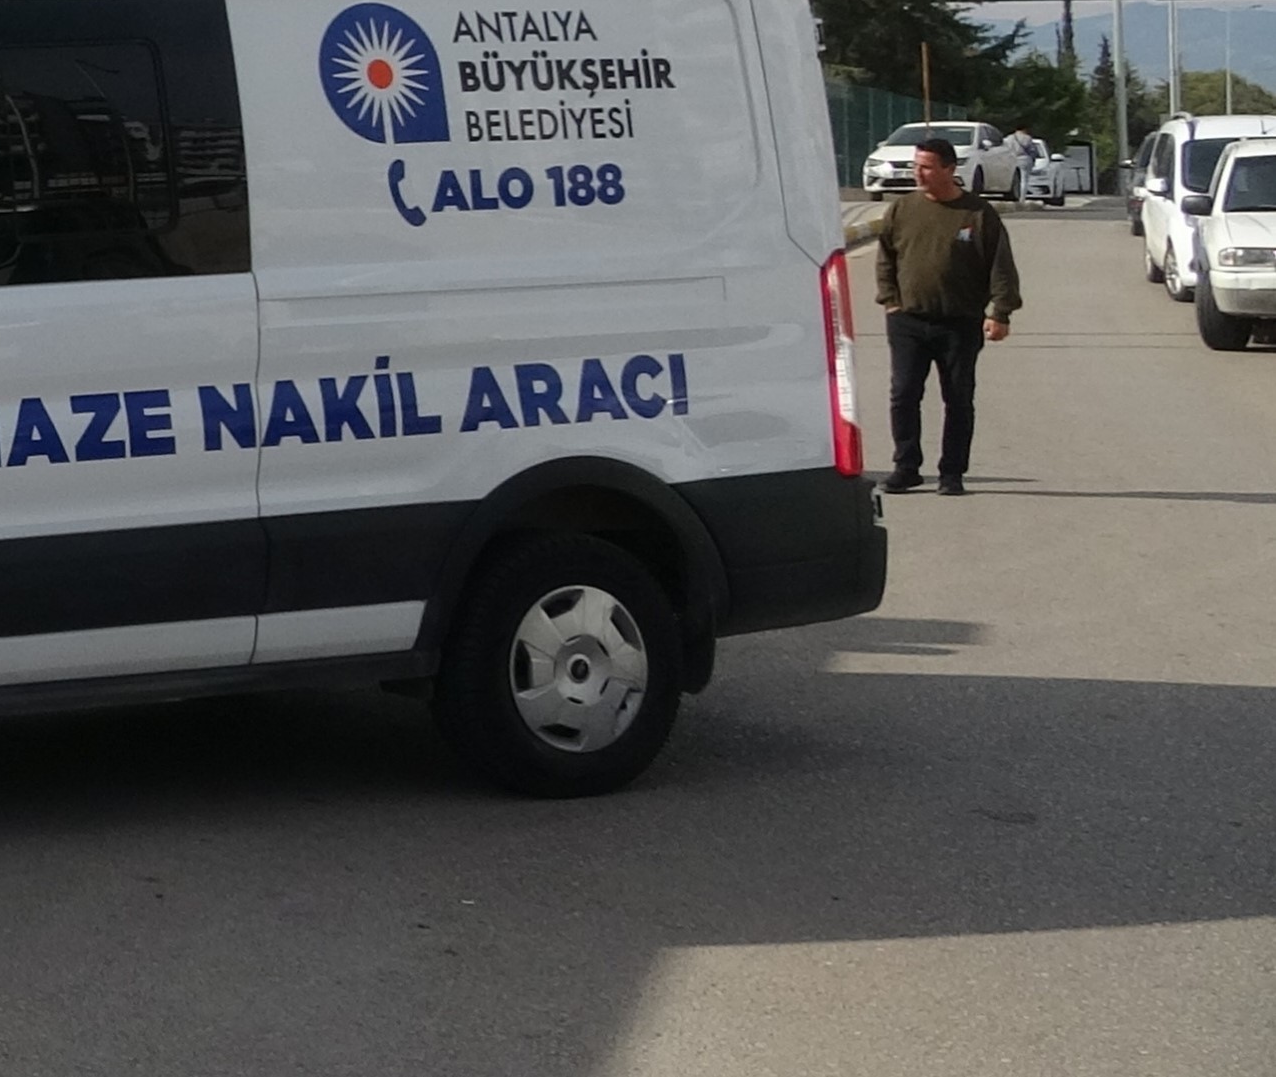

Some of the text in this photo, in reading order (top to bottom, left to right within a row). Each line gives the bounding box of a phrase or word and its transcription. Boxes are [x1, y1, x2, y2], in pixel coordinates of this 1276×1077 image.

[452, 10, 598, 44] ANTALYA
[459, 50, 677, 100] BÜYÜKŞEHİR
[465, 98, 635, 143] BELEDİYESİ
[430, 162, 626, 212] ALO 188
[197, 355, 443, 451] NAKİL
[459, 353, 690, 433] ARACI
